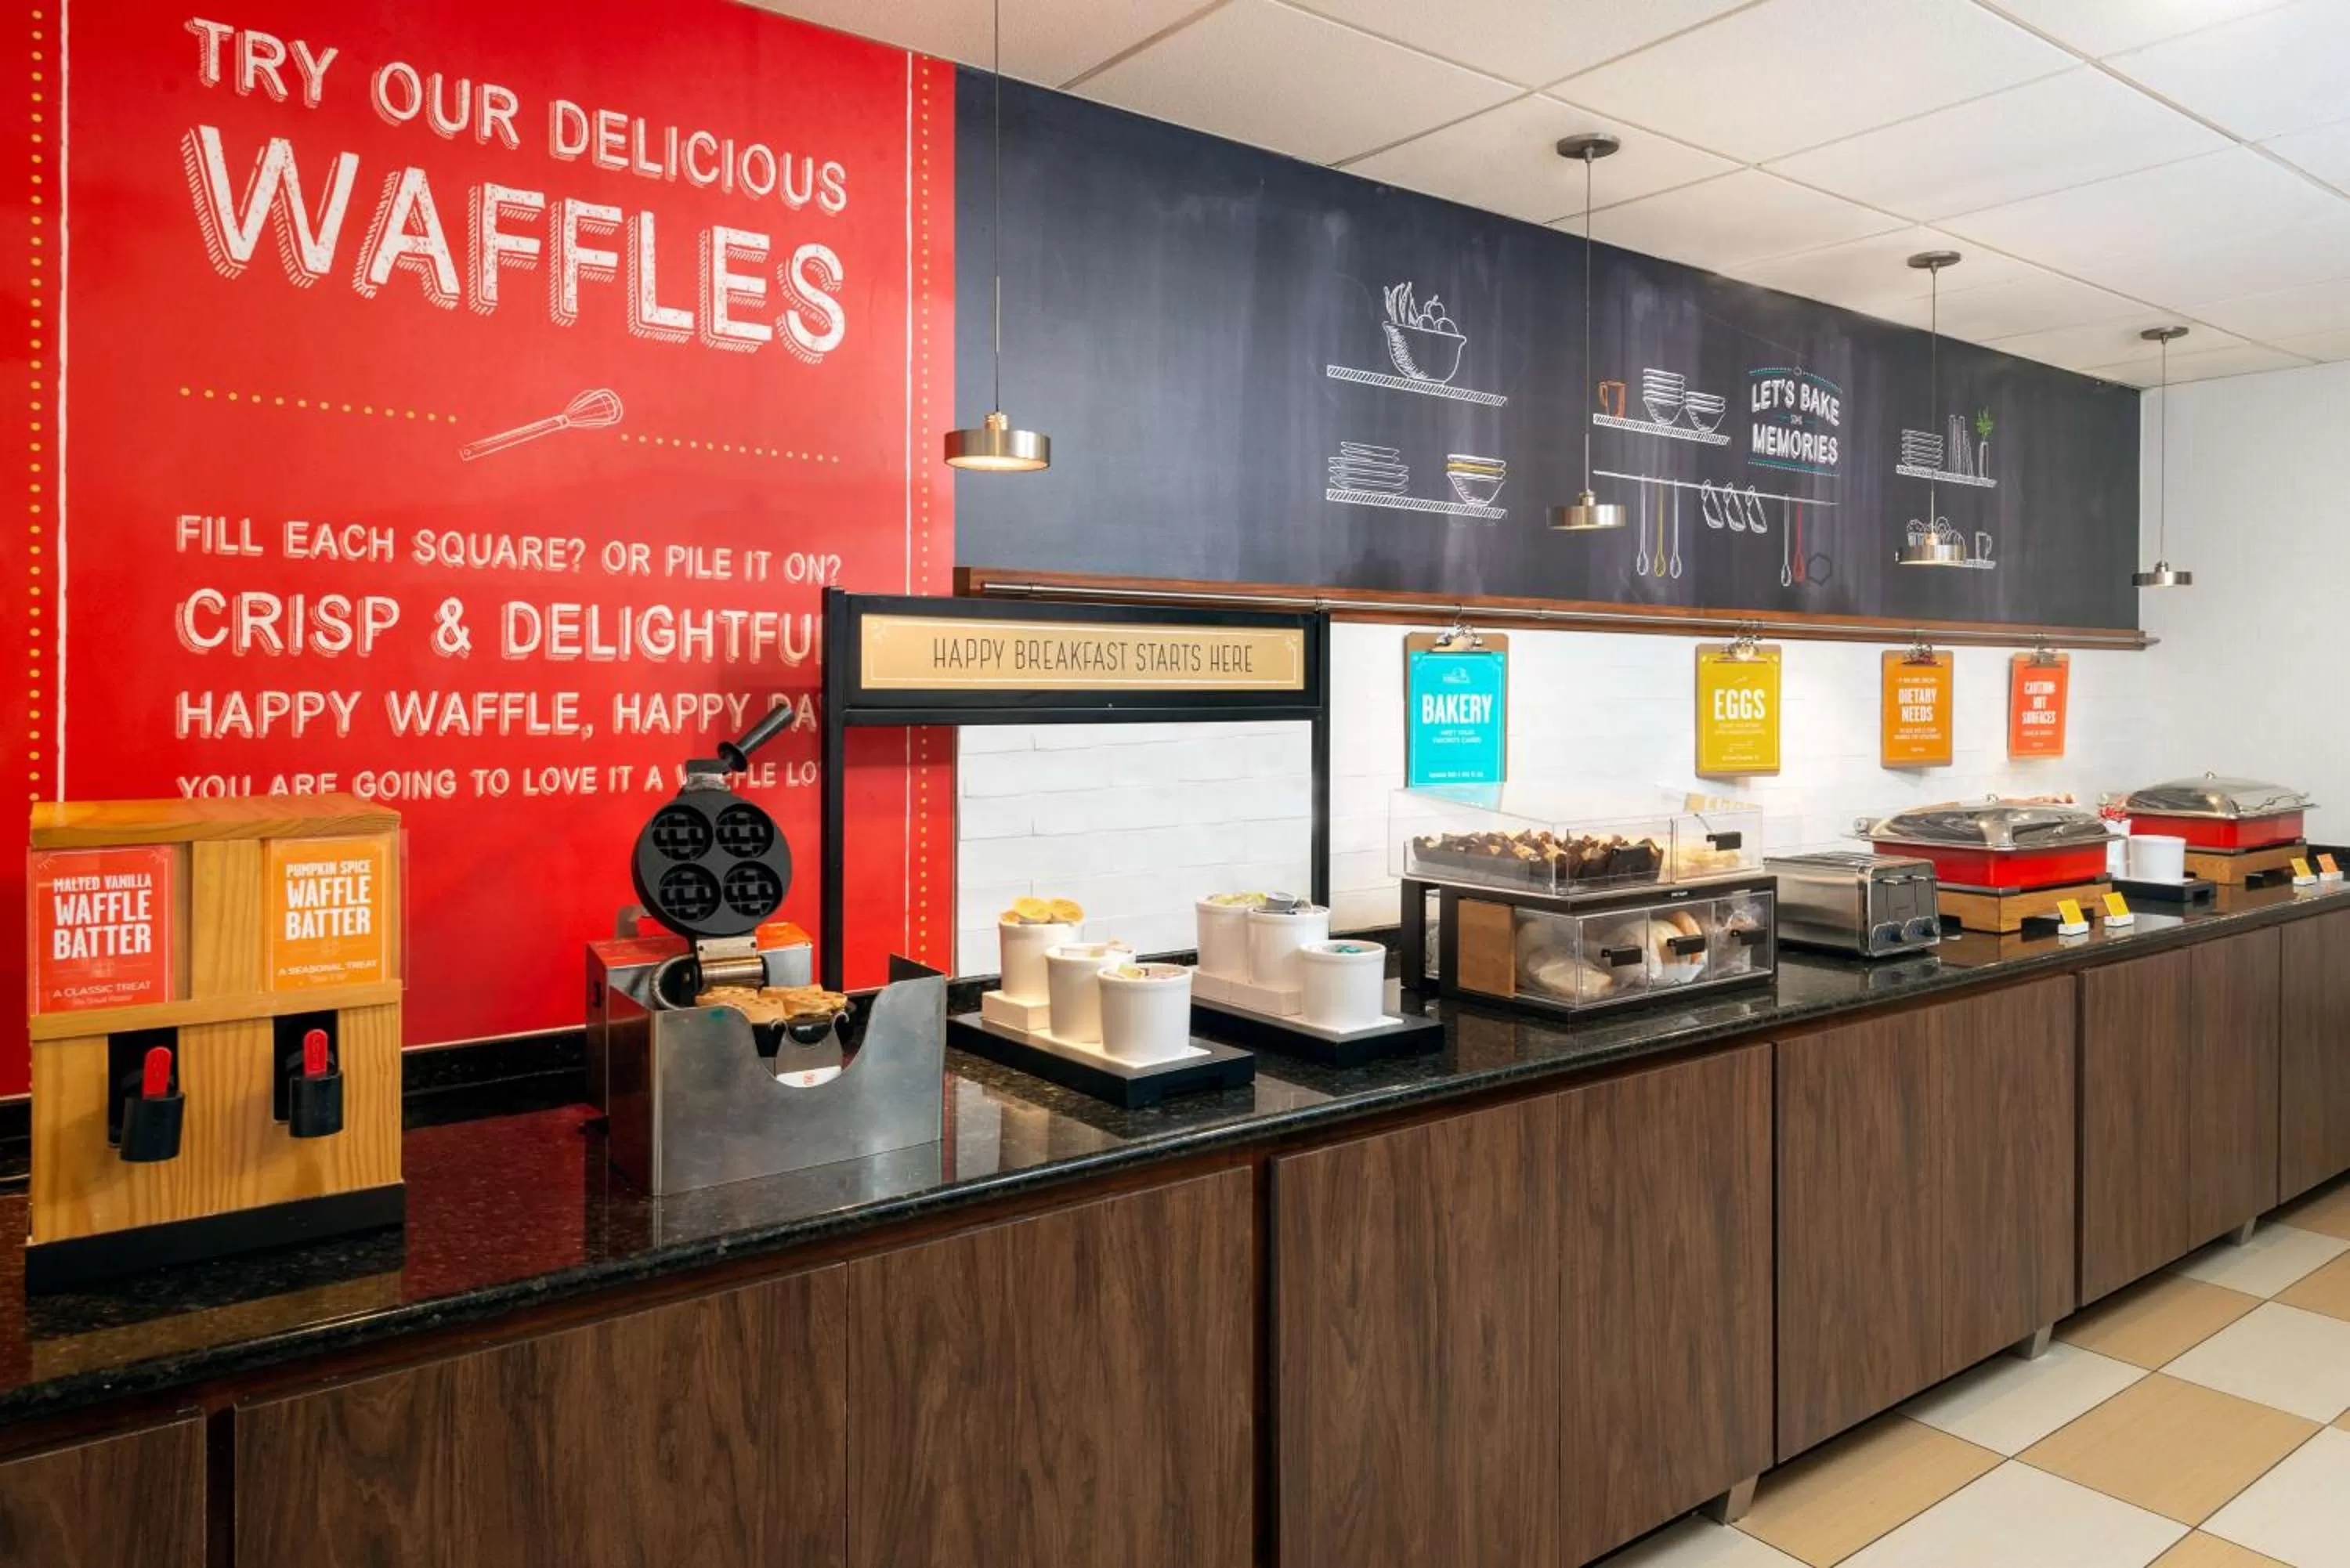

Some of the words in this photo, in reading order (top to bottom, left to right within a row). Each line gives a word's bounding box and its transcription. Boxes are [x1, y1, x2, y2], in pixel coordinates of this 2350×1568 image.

[184, 17, 338, 109] TRY
[371, 61, 520, 150] OUR
[549, 99, 848, 215] DELICIOUS
[180, 125, 845, 365] WAFFLES
[1751, 379, 1795, 413] LET'S
[1800, 383, 1839, 426] BAKE
[1752, 423, 1838, 465] MEMORIES
[175, 514, 264, 556] FILL
[283, 520, 394, 562] EACH
[412, 529, 587, 573] SQUARE?
[602, 540, 651, 576] OR
[664, 544, 732, 580] PILE
[744, 551, 772, 581] IT
[784, 552, 842, 586] ON?
[175, 587, 401, 657] CRISP
[431, 596, 472, 658] &
[501, 600, 822, 666] DELIGHTFU
[933, 638, 1005, 670] HAPPY
[1014, 640, 1128, 671] BREAKFAST
[1135, 642, 1202, 673] STARTS
[1210, 645, 1253, 674] HERE
[1422, 693, 1492, 724] BAKERY
[1713, 688, 1766, 721] EGGS
[1898, 688, 1937, 704] DIETARY
[1901, 705, 1933, 722] NEEDS
[175, 689, 362, 739] HAPPY
[385, 690, 594, 740] WAFFLE,
[613, 692, 751, 734] HAPPY
[175, 774, 251, 799] YOU
[268, 772, 338, 796] ARE
[352, 768, 457, 800] GOING
[469, 768, 511, 797] TO
[522, 765, 598, 797] LOVE
[608, 764, 634, 793] IT
[644, 764, 663, 791] A
[785, 761, 821, 787] LO
[52, 876, 100, 892] MALTED
[104, 873, 152, 890] VANILLA
[286, 862, 337, 877] PUMPKIN
[340, 859, 371, 874] SPICE
[53, 890, 152, 926] WAFFLE
[287, 876, 371, 909] WAFFLE
[52, 923, 152, 959] BATTER
[285, 906, 371, 941] BATTER
[52, 989, 62, 998] A
[63, 985, 114, 997] CLASSIC
[115, 981, 151, 992] TREAT
